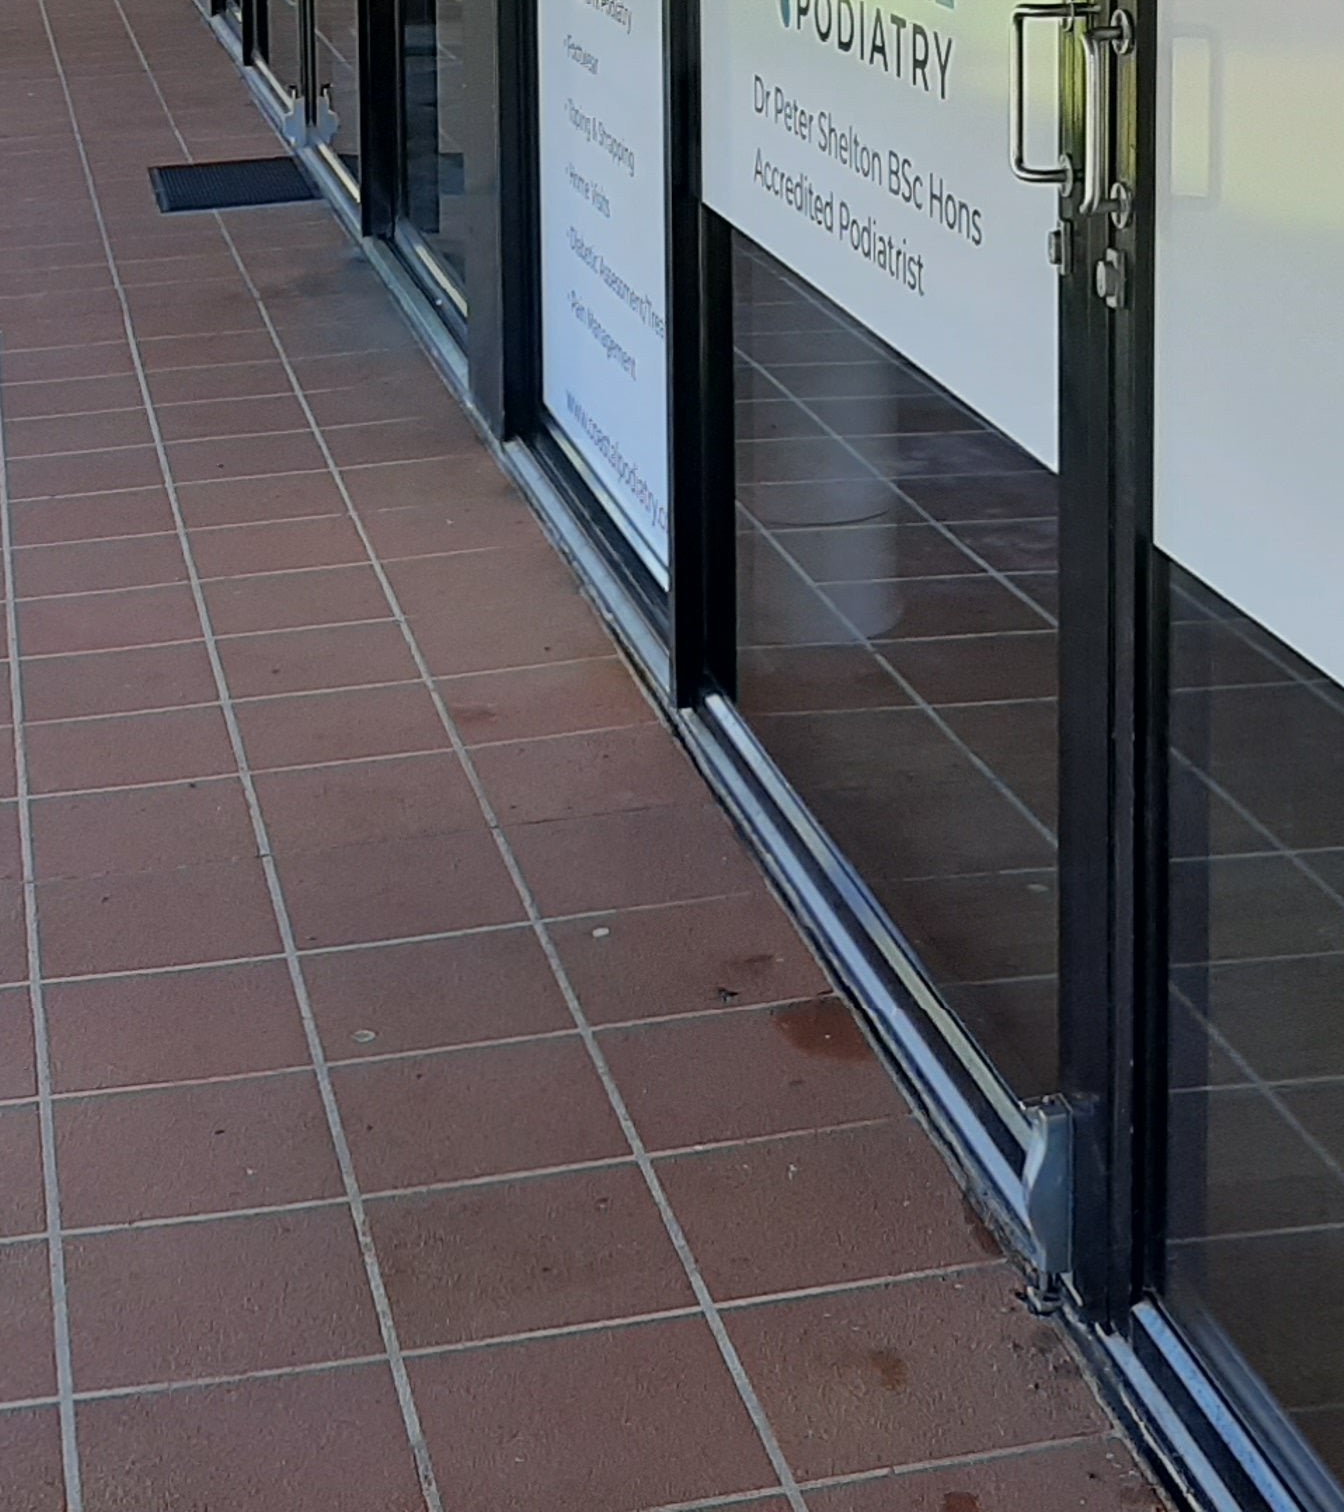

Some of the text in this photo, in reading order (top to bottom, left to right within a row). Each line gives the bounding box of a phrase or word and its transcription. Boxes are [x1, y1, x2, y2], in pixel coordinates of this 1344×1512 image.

[753, 74, 982, 246] Dr Peter Shelton BSc Hons
[753, 146, 925, 297] Accredited Podiatrist
